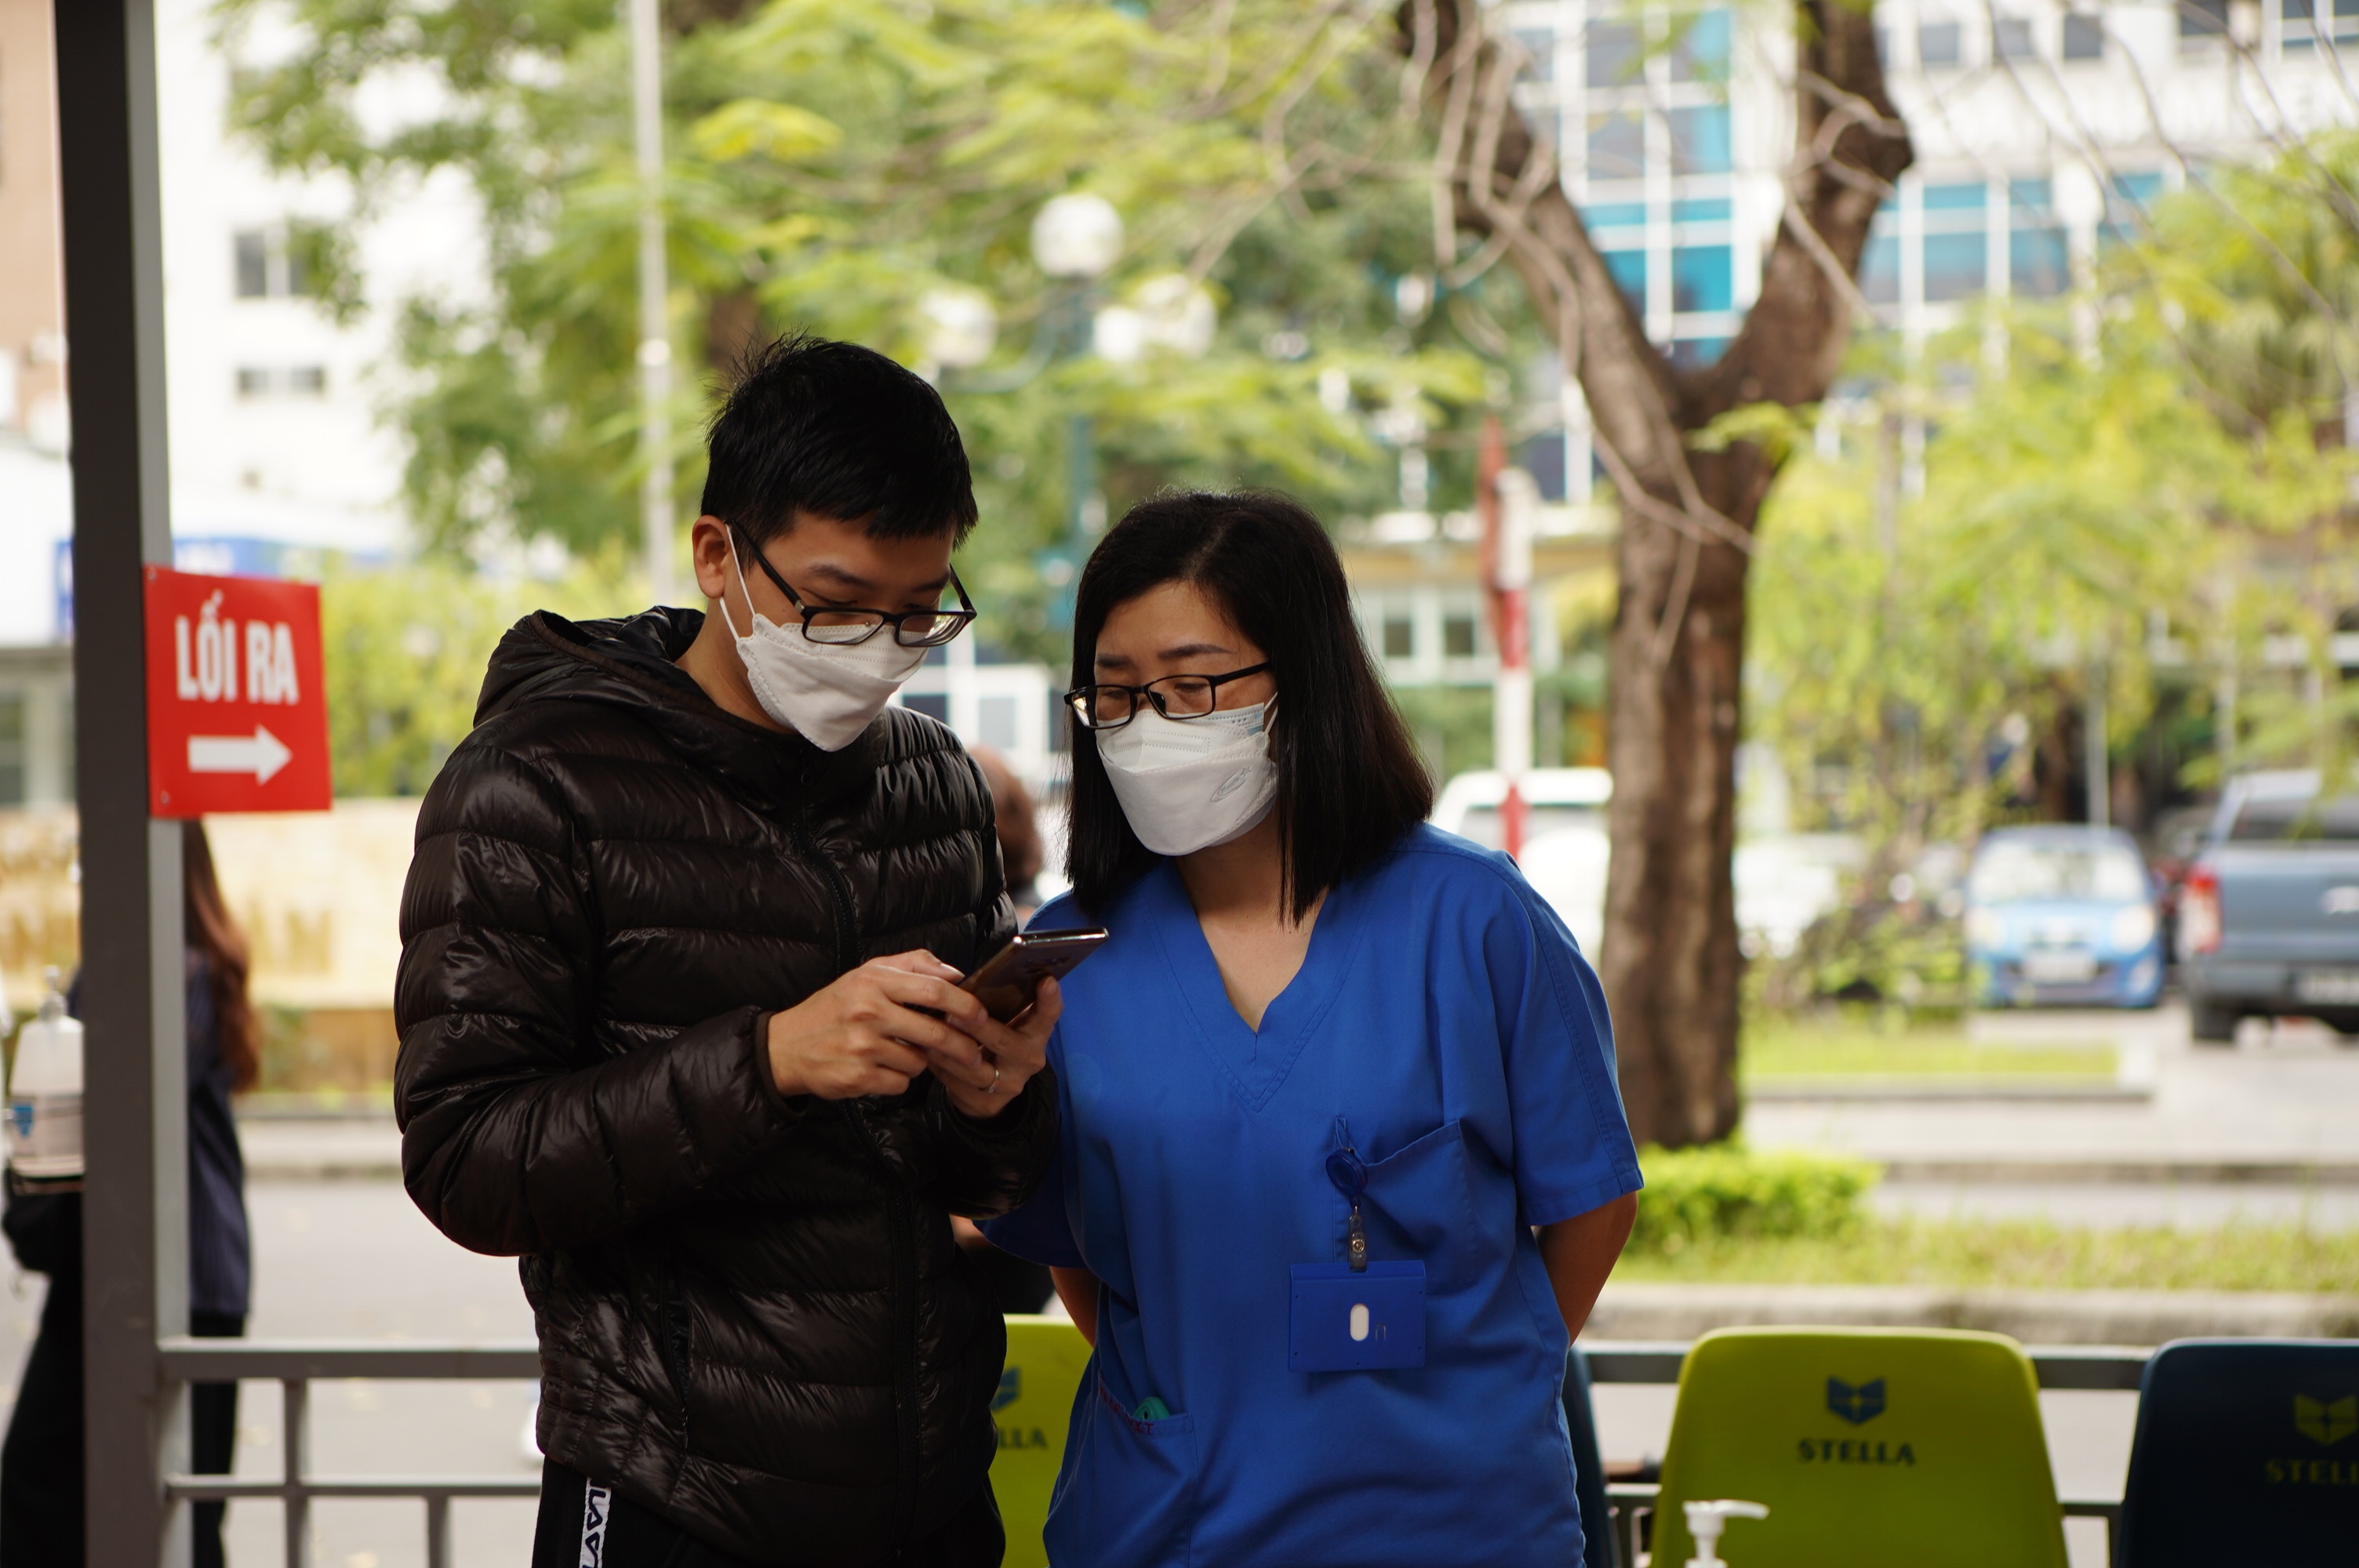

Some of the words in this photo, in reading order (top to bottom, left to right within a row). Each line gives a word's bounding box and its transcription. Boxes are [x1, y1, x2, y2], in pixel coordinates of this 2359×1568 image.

[174, 588, 238, 703] LỐI
[245, 619, 301, 706] RA
[1797, 1438, 1917, 1466] STELLA
